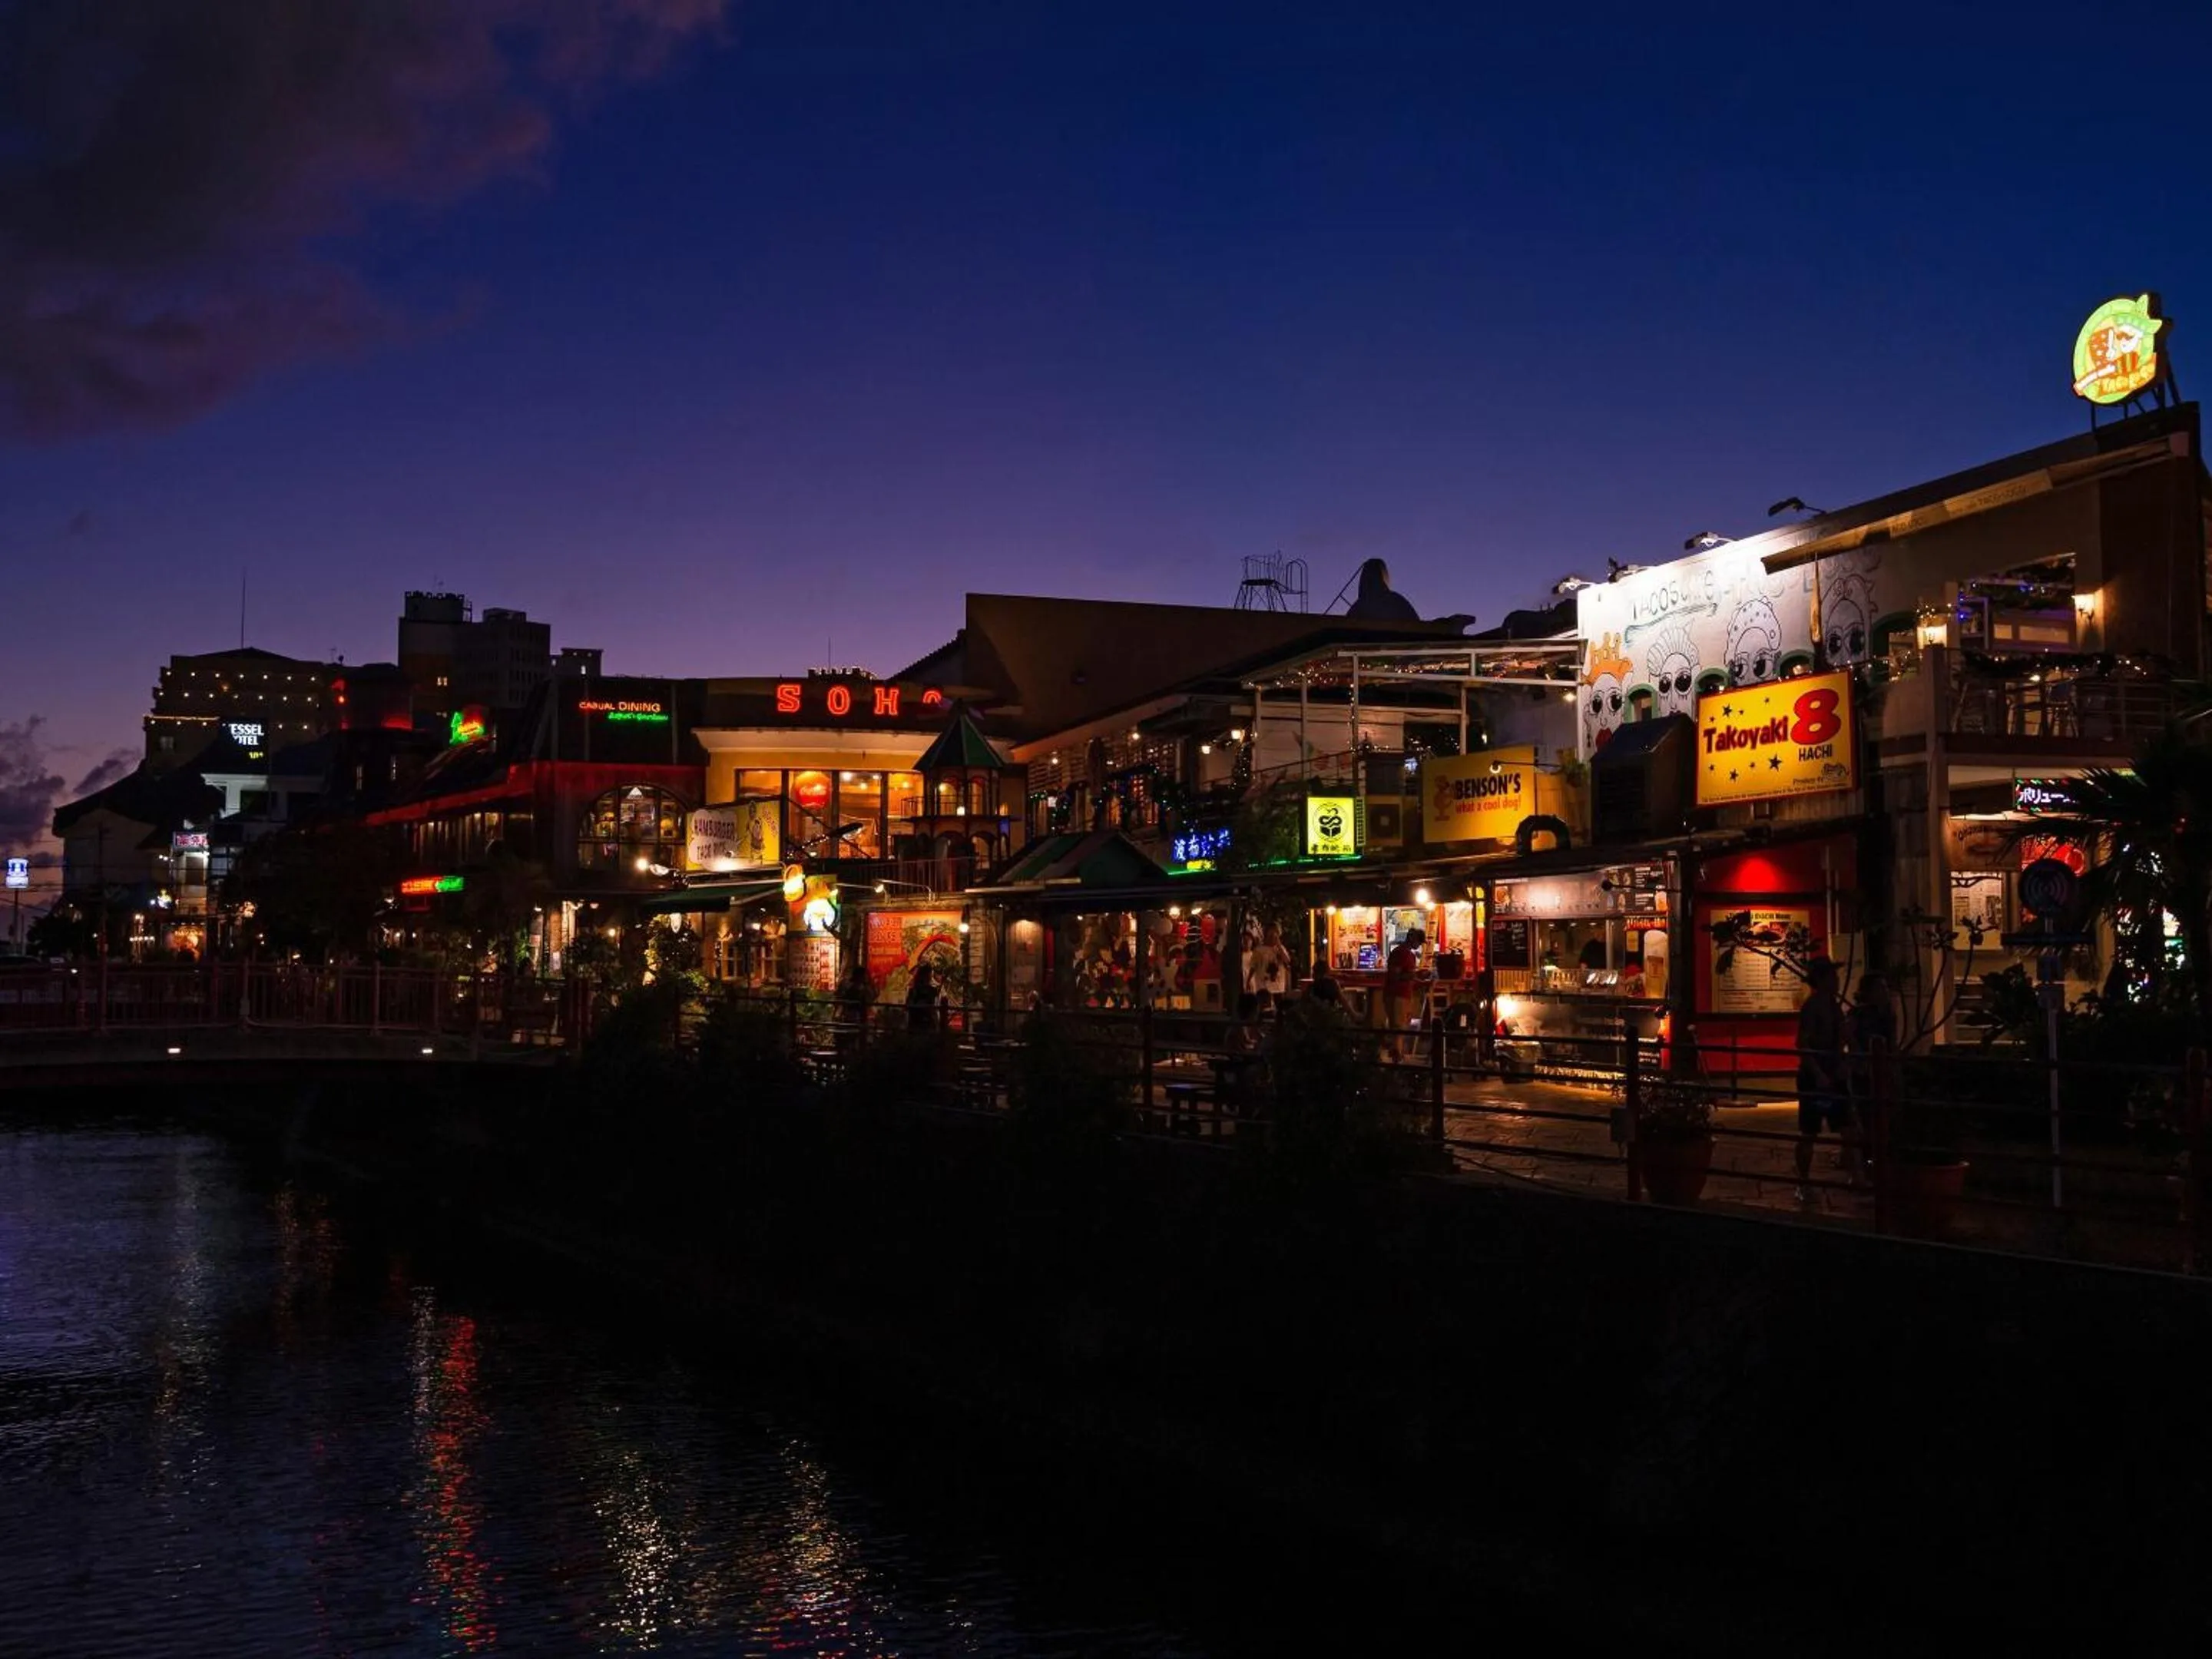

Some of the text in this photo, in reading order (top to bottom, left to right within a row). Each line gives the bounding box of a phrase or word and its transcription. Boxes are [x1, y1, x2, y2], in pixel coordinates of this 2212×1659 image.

[618, 701, 661, 713] DINING
[1790, 688, 1841, 745] 8
[228, 724, 264, 737] ESSEL
[1799, 743, 1833, 761] HACHI
[1455, 773, 1521, 800] BENSON'S
[1455, 796, 1521, 813] what a cool dog!
